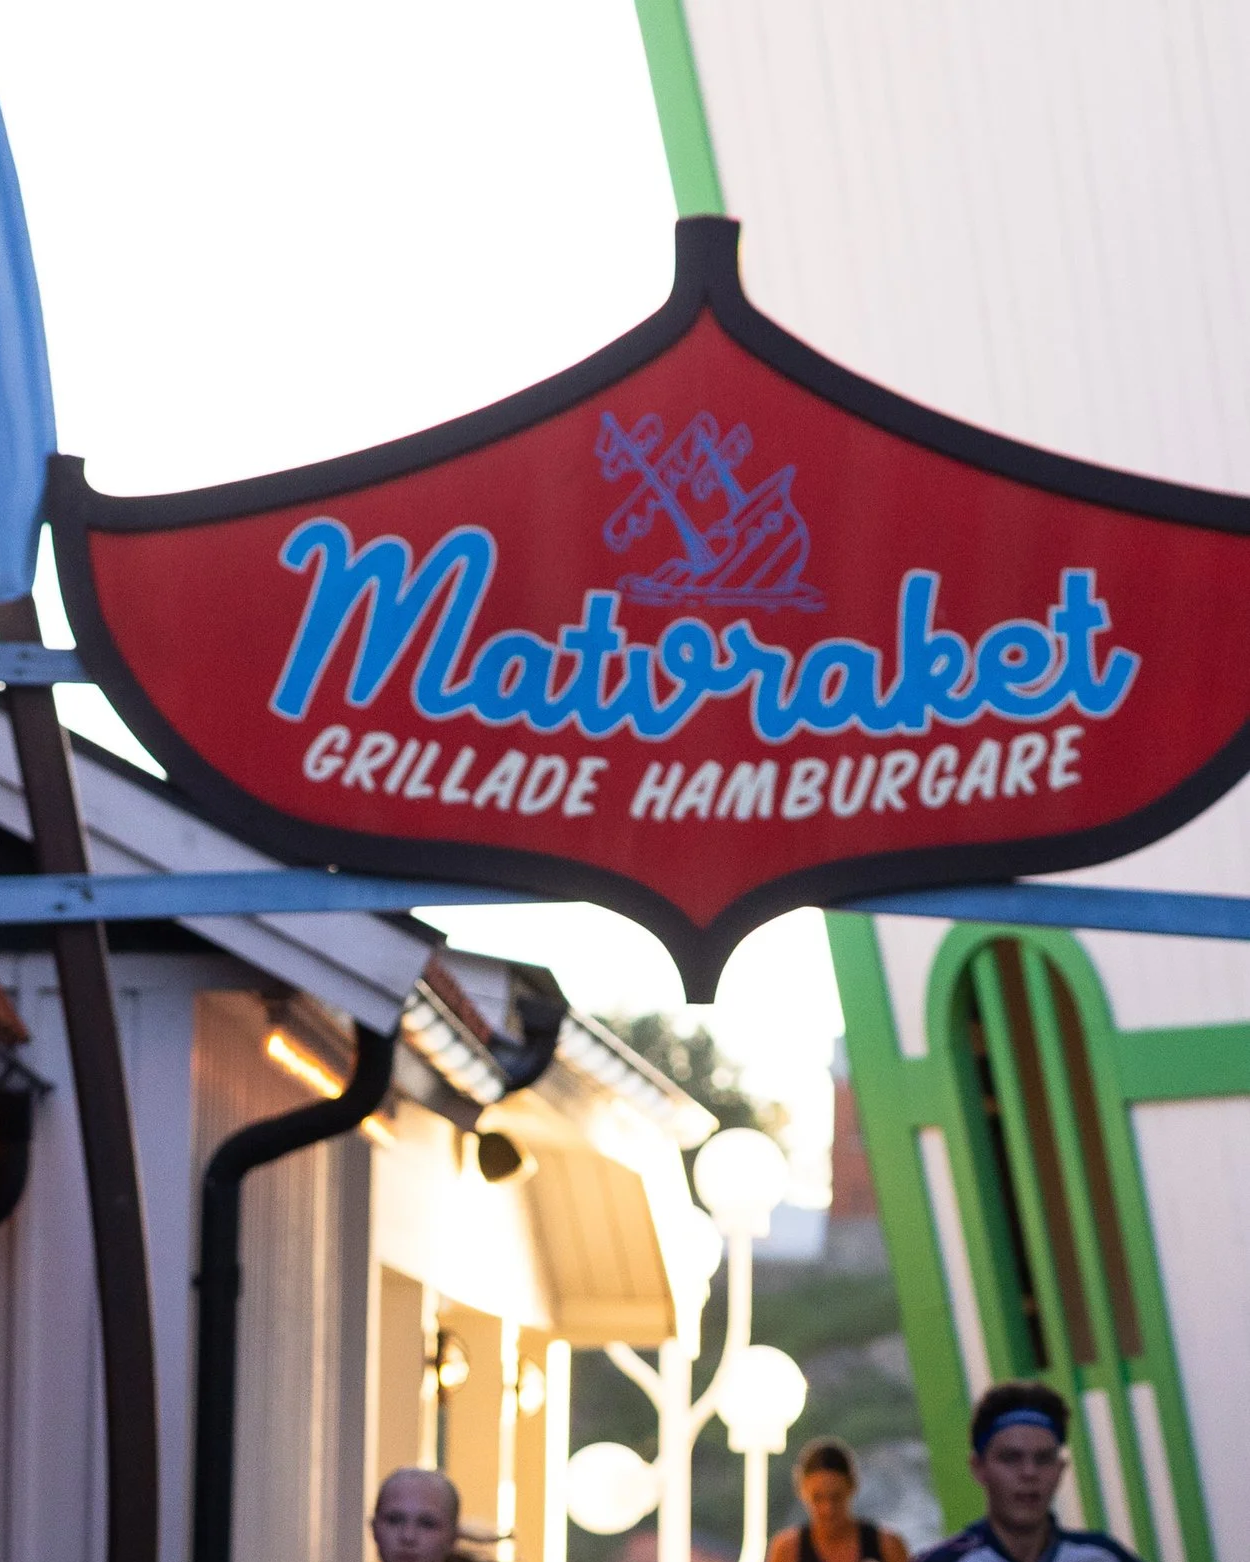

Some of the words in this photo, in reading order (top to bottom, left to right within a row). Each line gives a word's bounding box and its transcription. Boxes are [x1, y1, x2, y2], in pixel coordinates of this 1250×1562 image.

[269, 515, 1141, 742] Matvraket
[303, 724, 610, 818] GRILLADE
[629, 724, 1086, 822] HAMBURGARE
